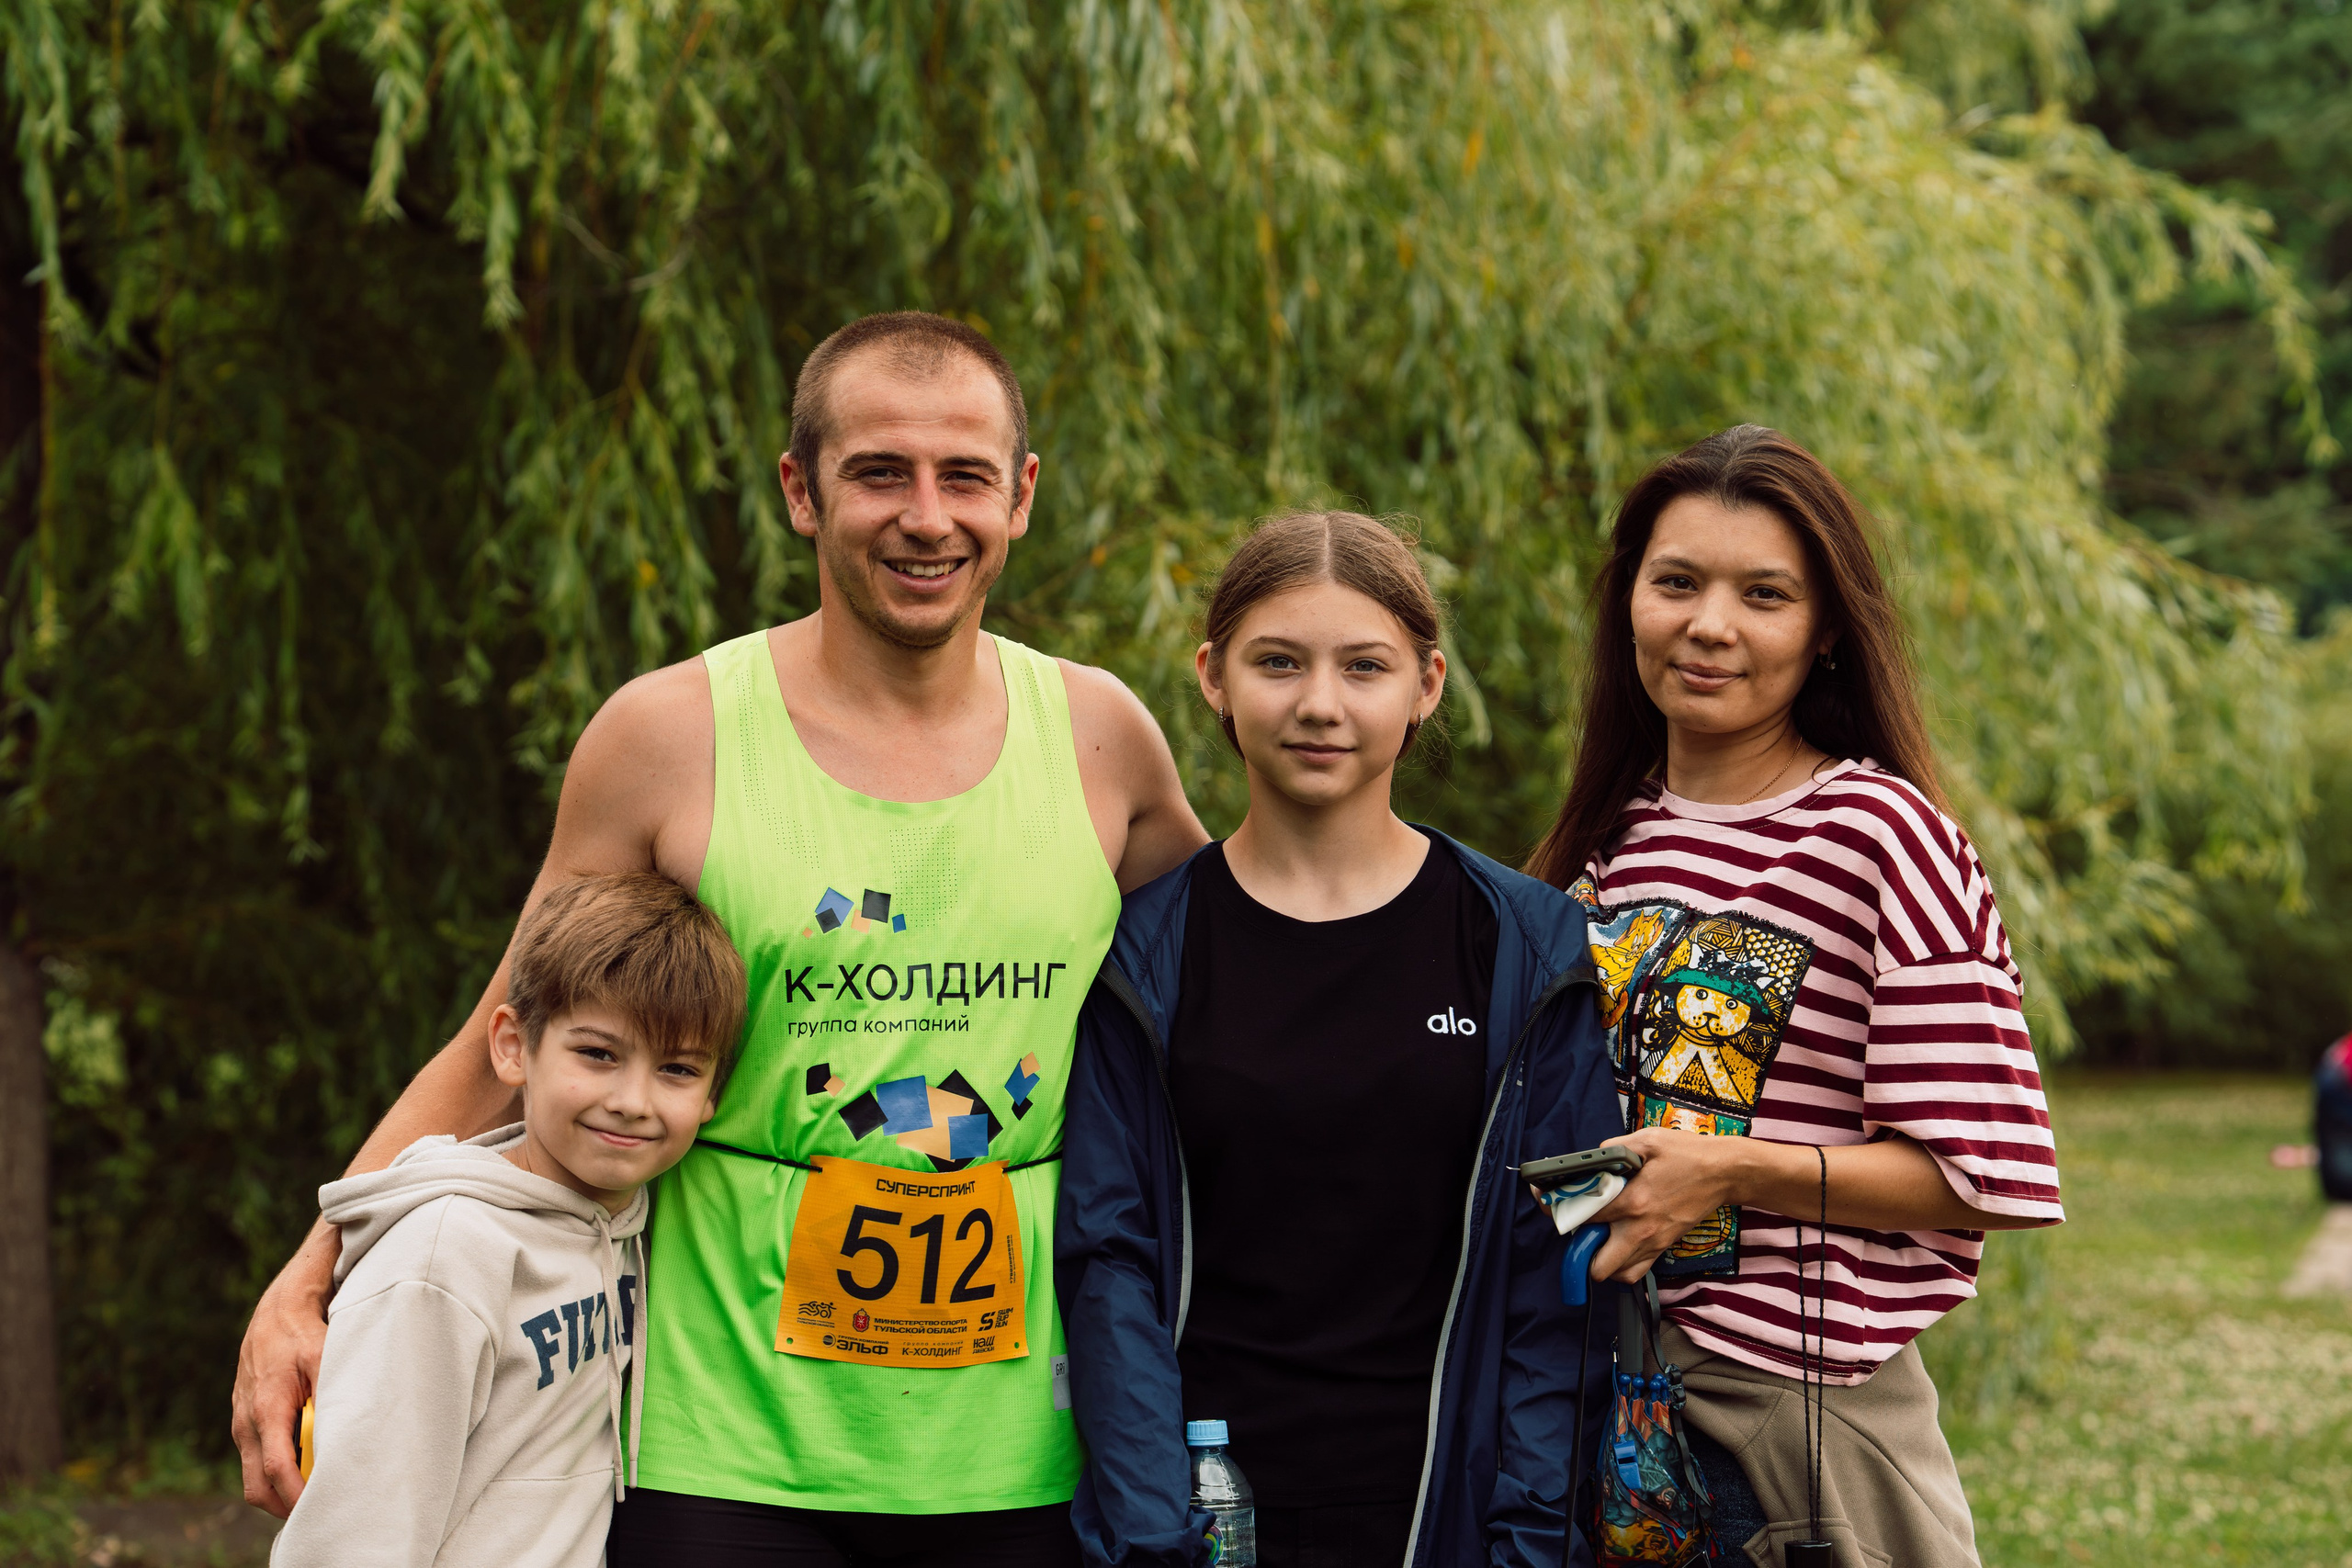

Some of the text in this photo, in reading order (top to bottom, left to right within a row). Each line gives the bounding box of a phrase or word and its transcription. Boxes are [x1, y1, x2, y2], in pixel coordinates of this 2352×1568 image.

[785, 962, 1067, 1007] К-ХОЛДИНГ
[788, 1014, 969, 1038] группа компаний
[1427, 1006, 1476, 1036] alo
[876, 1178, 977, 1198] СУПЕРСПРИНТ
[836, 1204, 996, 1304] 512
[874, 1317, 967, 1326] МИНИСТЕРСТВО СПОРТА
[874, 1325, 967, 1335] ТУЛЬСКОЙ ОБЛАСТИ
[836, 1340, 889, 1355] ЭЛЬФ
[901, 1346, 964, 1358] К-ХОЛДИНГ
